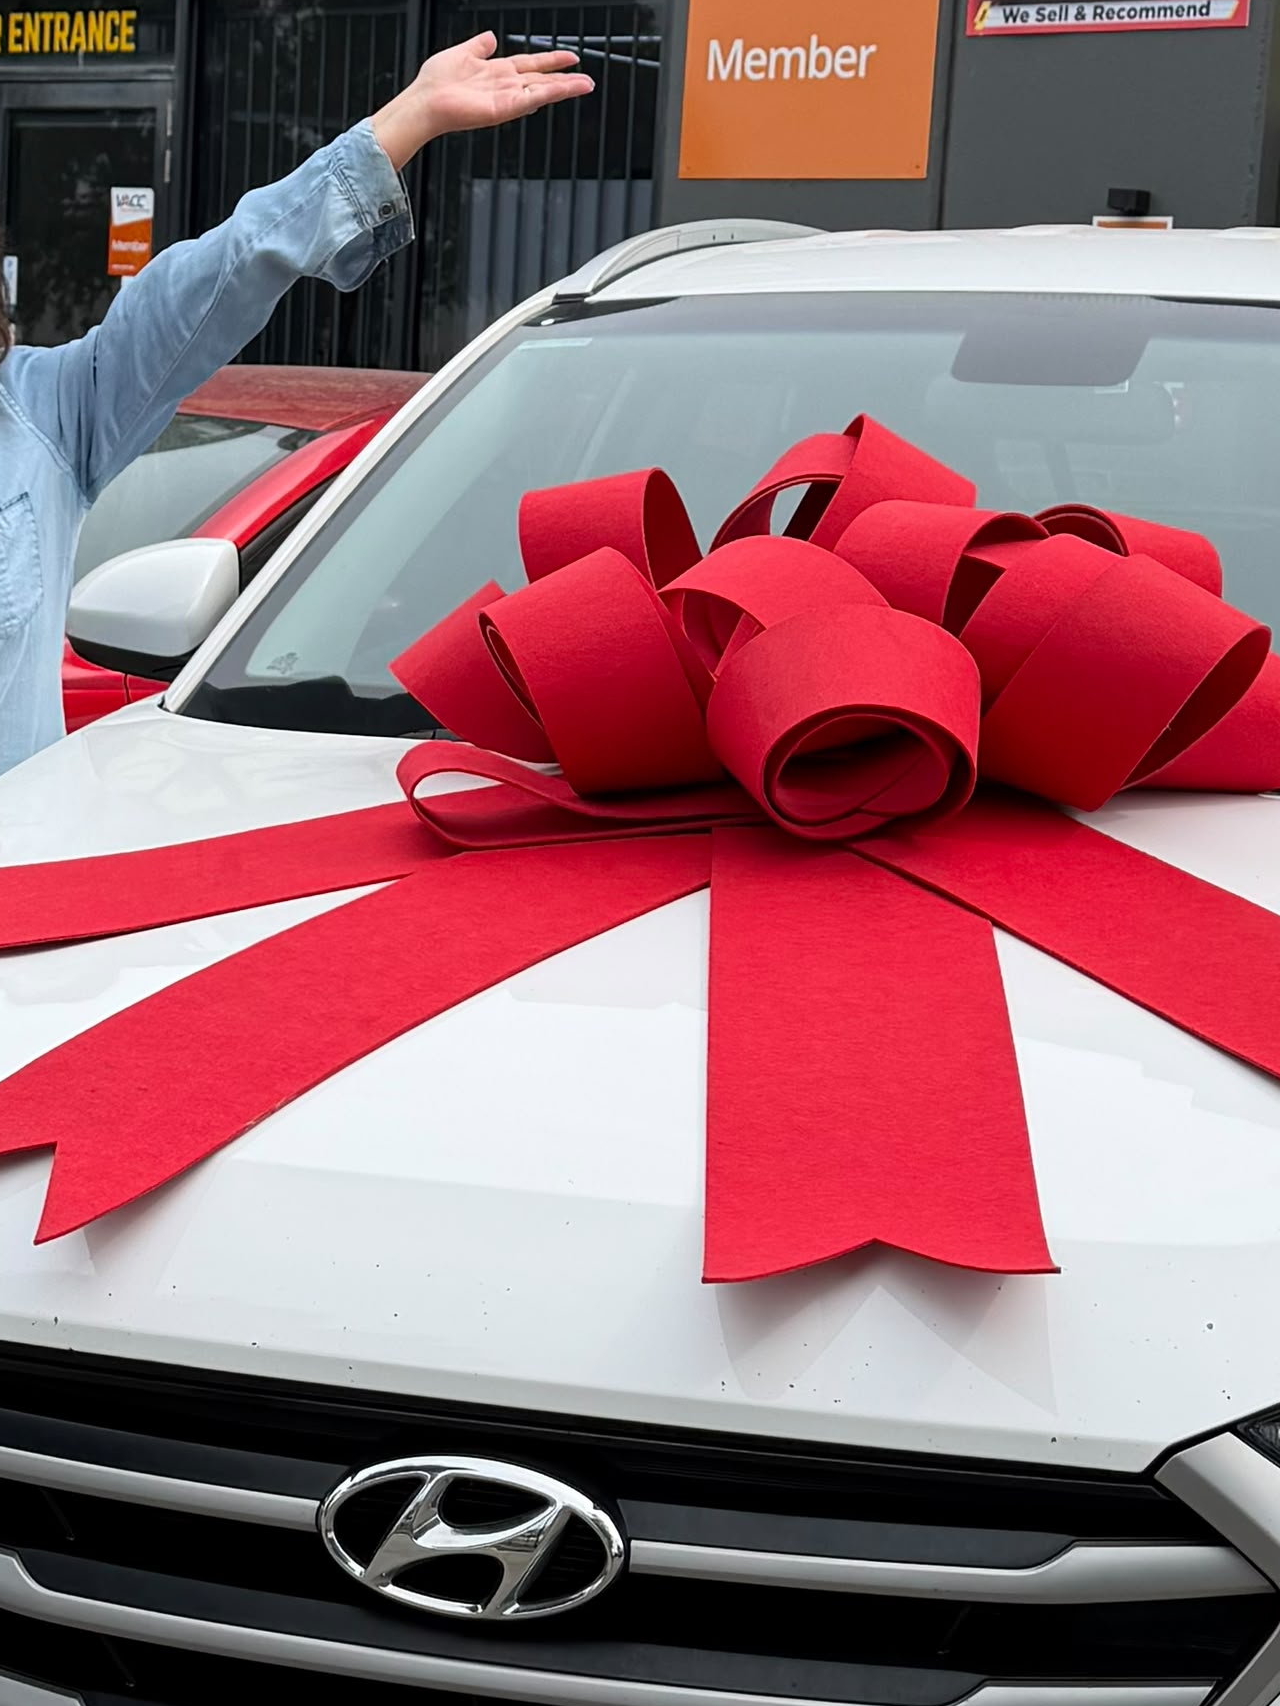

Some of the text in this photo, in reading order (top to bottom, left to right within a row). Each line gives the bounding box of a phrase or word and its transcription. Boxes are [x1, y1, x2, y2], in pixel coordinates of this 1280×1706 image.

[7, 10, 137, 53] ENTRANCE
[1002, 0, 1211, 24] We Sell & Recommend
[706, 34, 877, 81] Member
